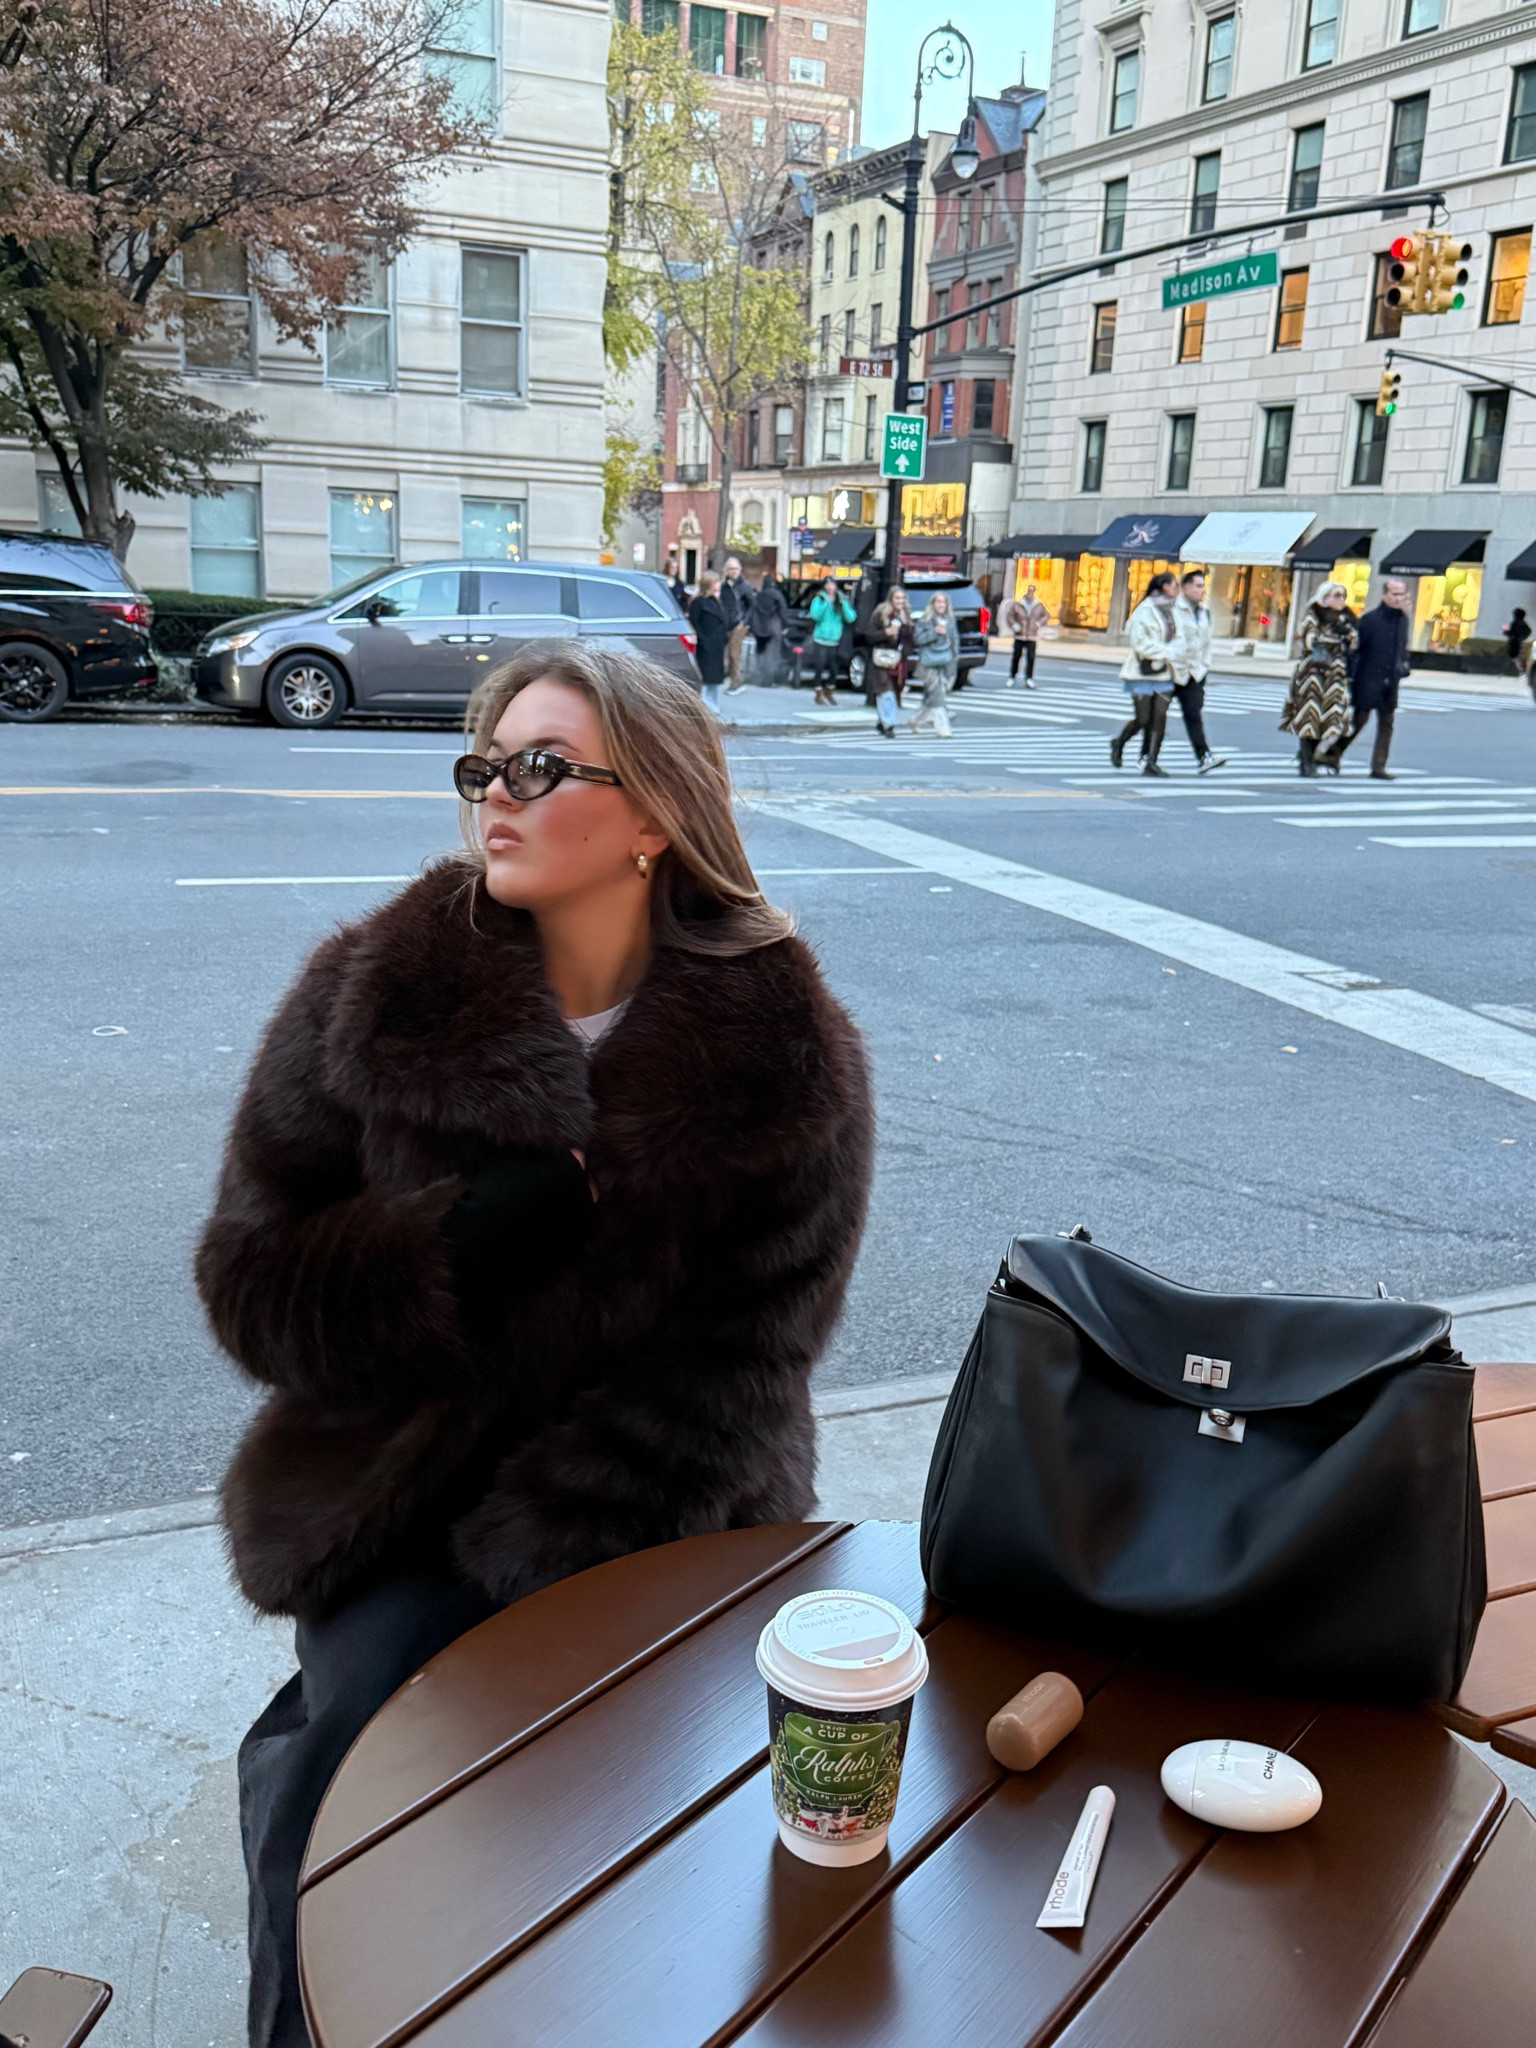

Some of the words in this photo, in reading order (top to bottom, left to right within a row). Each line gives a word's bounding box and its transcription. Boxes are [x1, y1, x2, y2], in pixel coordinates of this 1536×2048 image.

[1170, 272, 1232, 300] Madison
[1237, 265, 1260, 283] Av
[889, 420, 921, 435] West
[889, 437, 918, 451] Side
[798, 1614, 849, 1631] TRAVELER
[853, 1609, 870, 1619] LID
[803, 1725, 813, 1736] A
[818, 1729, 846, 1740] CUP
[851, 1732, 870, 1740] OF
[819, 1723, 847, 1733] ENJOY
[793, 1746, 875, 1786] Ralph's
[824, 1771, 874, 1782] COFFEE
[806, 1789, 830, 1800] RALPH
[833, 1793, 863, 1801] LAUREN
[1049, 1871, 1069, 1910] rhode
